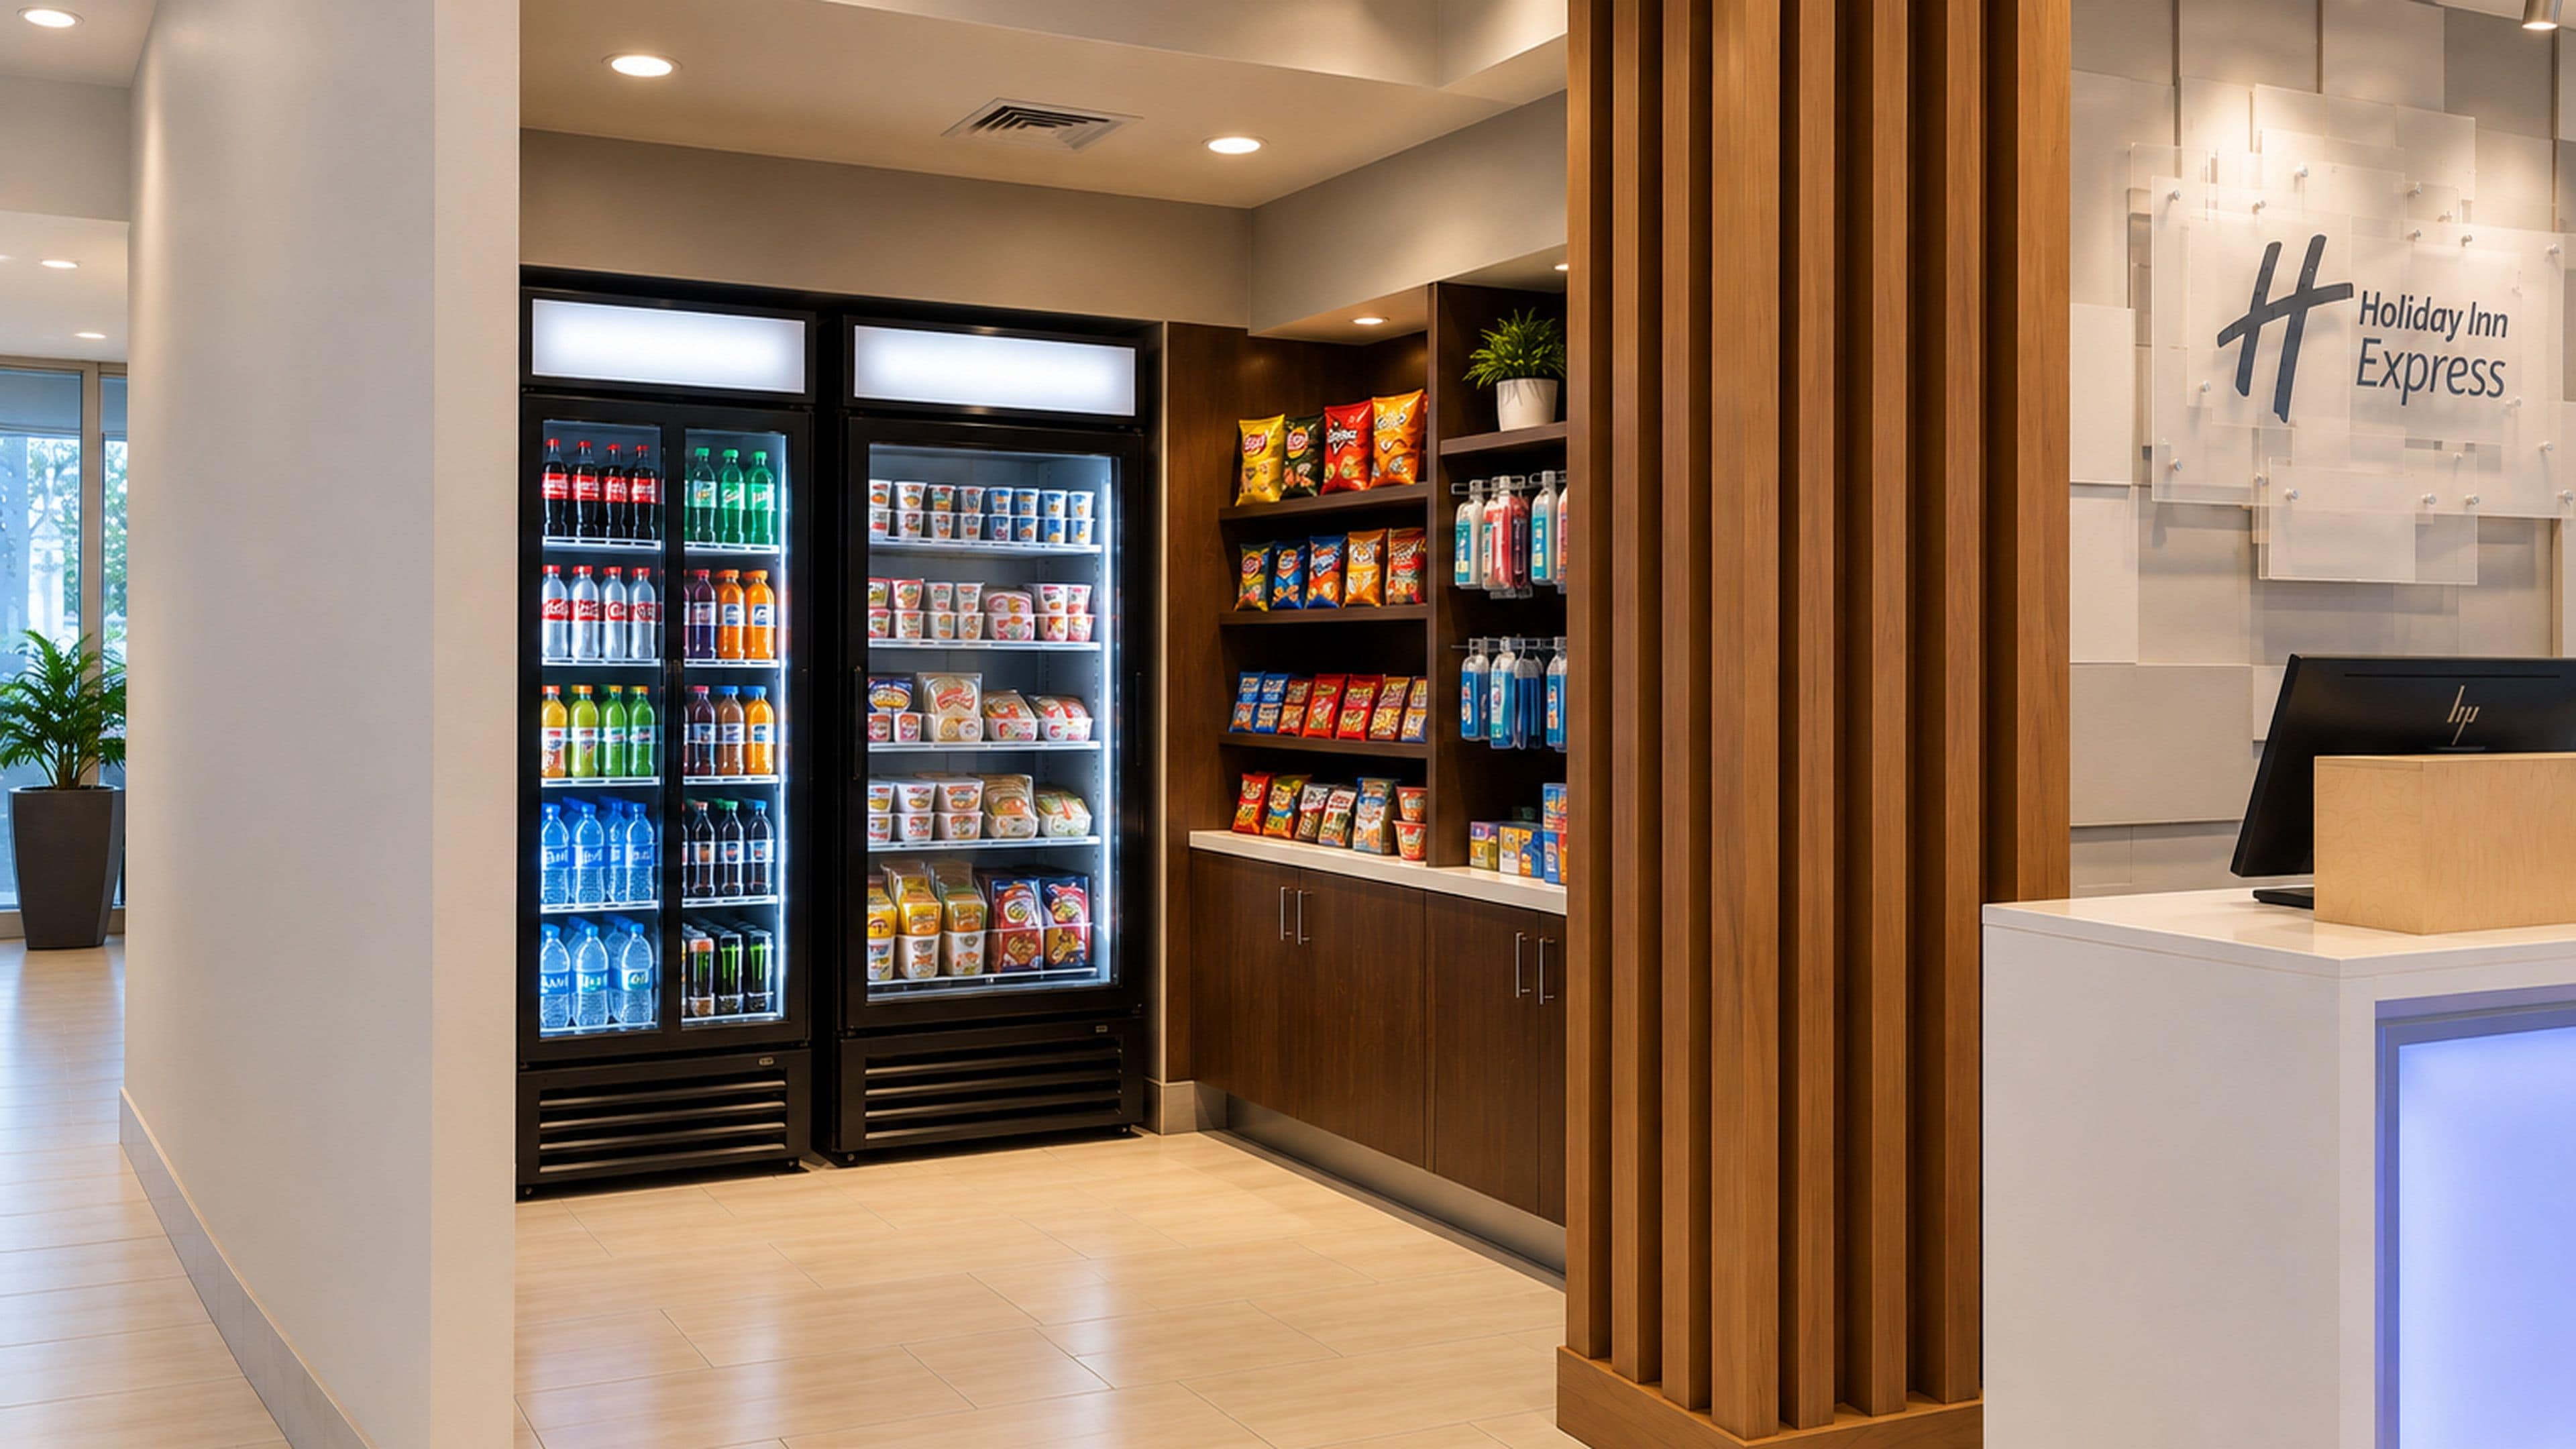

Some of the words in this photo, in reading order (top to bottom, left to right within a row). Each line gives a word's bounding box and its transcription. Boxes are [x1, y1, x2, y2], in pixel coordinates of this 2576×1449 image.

[2359, 290, 2464, 343] Holiday
[2467, 301, 2508, 339] Inn
[2356, 337, 2506, 407] Express
[2446, 684, 2481, 746] hp
